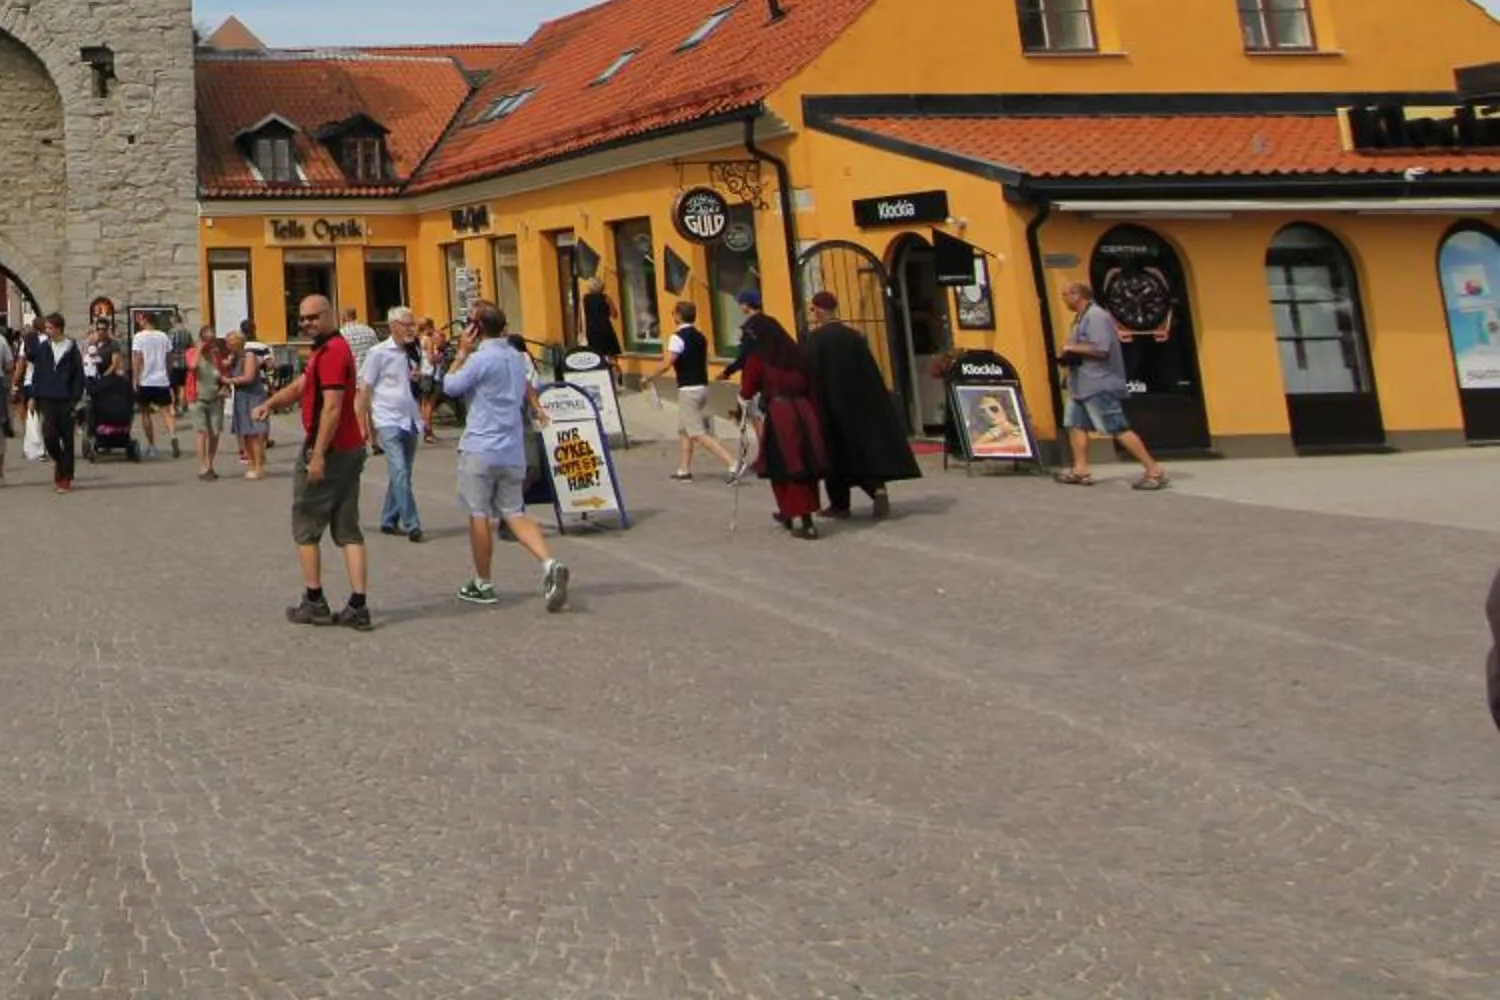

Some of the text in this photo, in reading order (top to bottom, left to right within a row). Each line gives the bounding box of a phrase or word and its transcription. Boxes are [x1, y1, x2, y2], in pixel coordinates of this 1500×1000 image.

[877, 200, 916, 219] Klockia
[269, 218, 362, 241] Tells Optik
[684, 214, 725, 237] GULD
[961, 363, 1003, 375] Klockia
[553, 440, 595, 463] CYKEL
